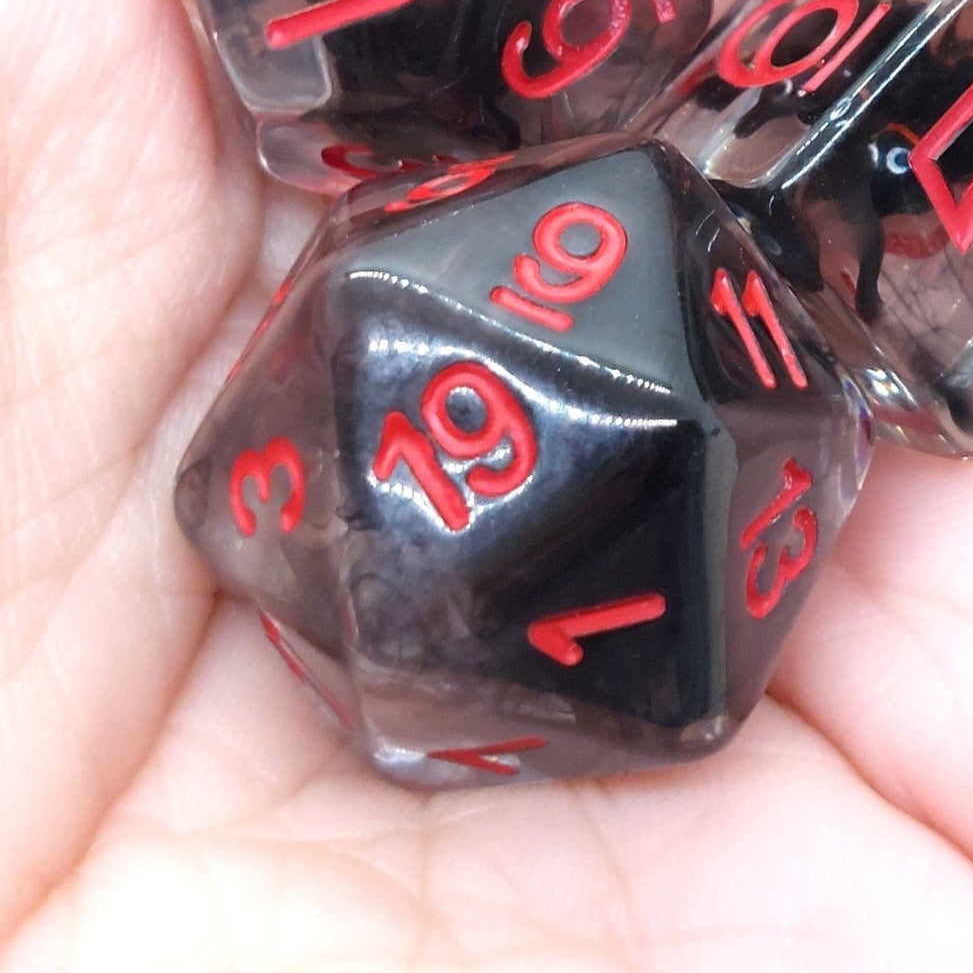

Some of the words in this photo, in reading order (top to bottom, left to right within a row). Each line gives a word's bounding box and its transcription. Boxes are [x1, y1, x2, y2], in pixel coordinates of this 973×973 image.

[710, 268, 808, 389] 11
[228, 436, 306, 537] 3
[372, 361, 538, 533] 19
[741, 458, 818, 619] 13
[527, 593, 667, 667] 1
